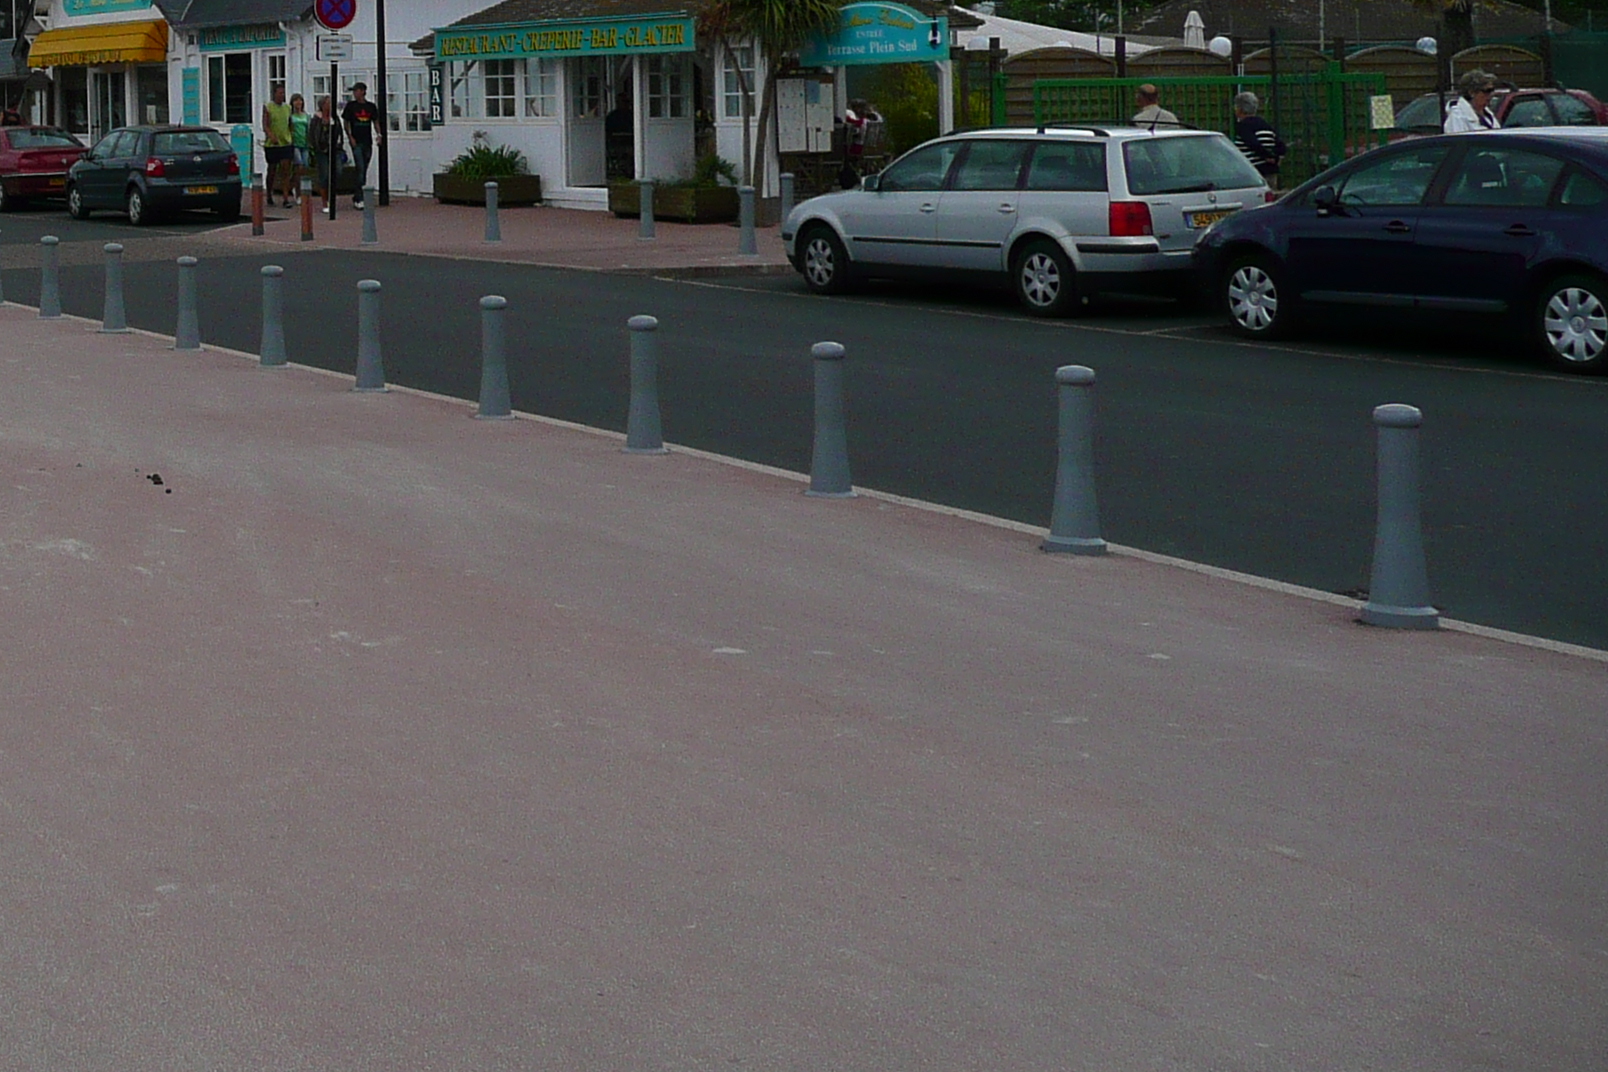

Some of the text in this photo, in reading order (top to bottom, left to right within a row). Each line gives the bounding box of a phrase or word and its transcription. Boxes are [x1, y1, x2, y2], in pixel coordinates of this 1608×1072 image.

[827, 39, 918, 56] Terrasse Plein Sud
[431, 70, 442, 121] BAR
